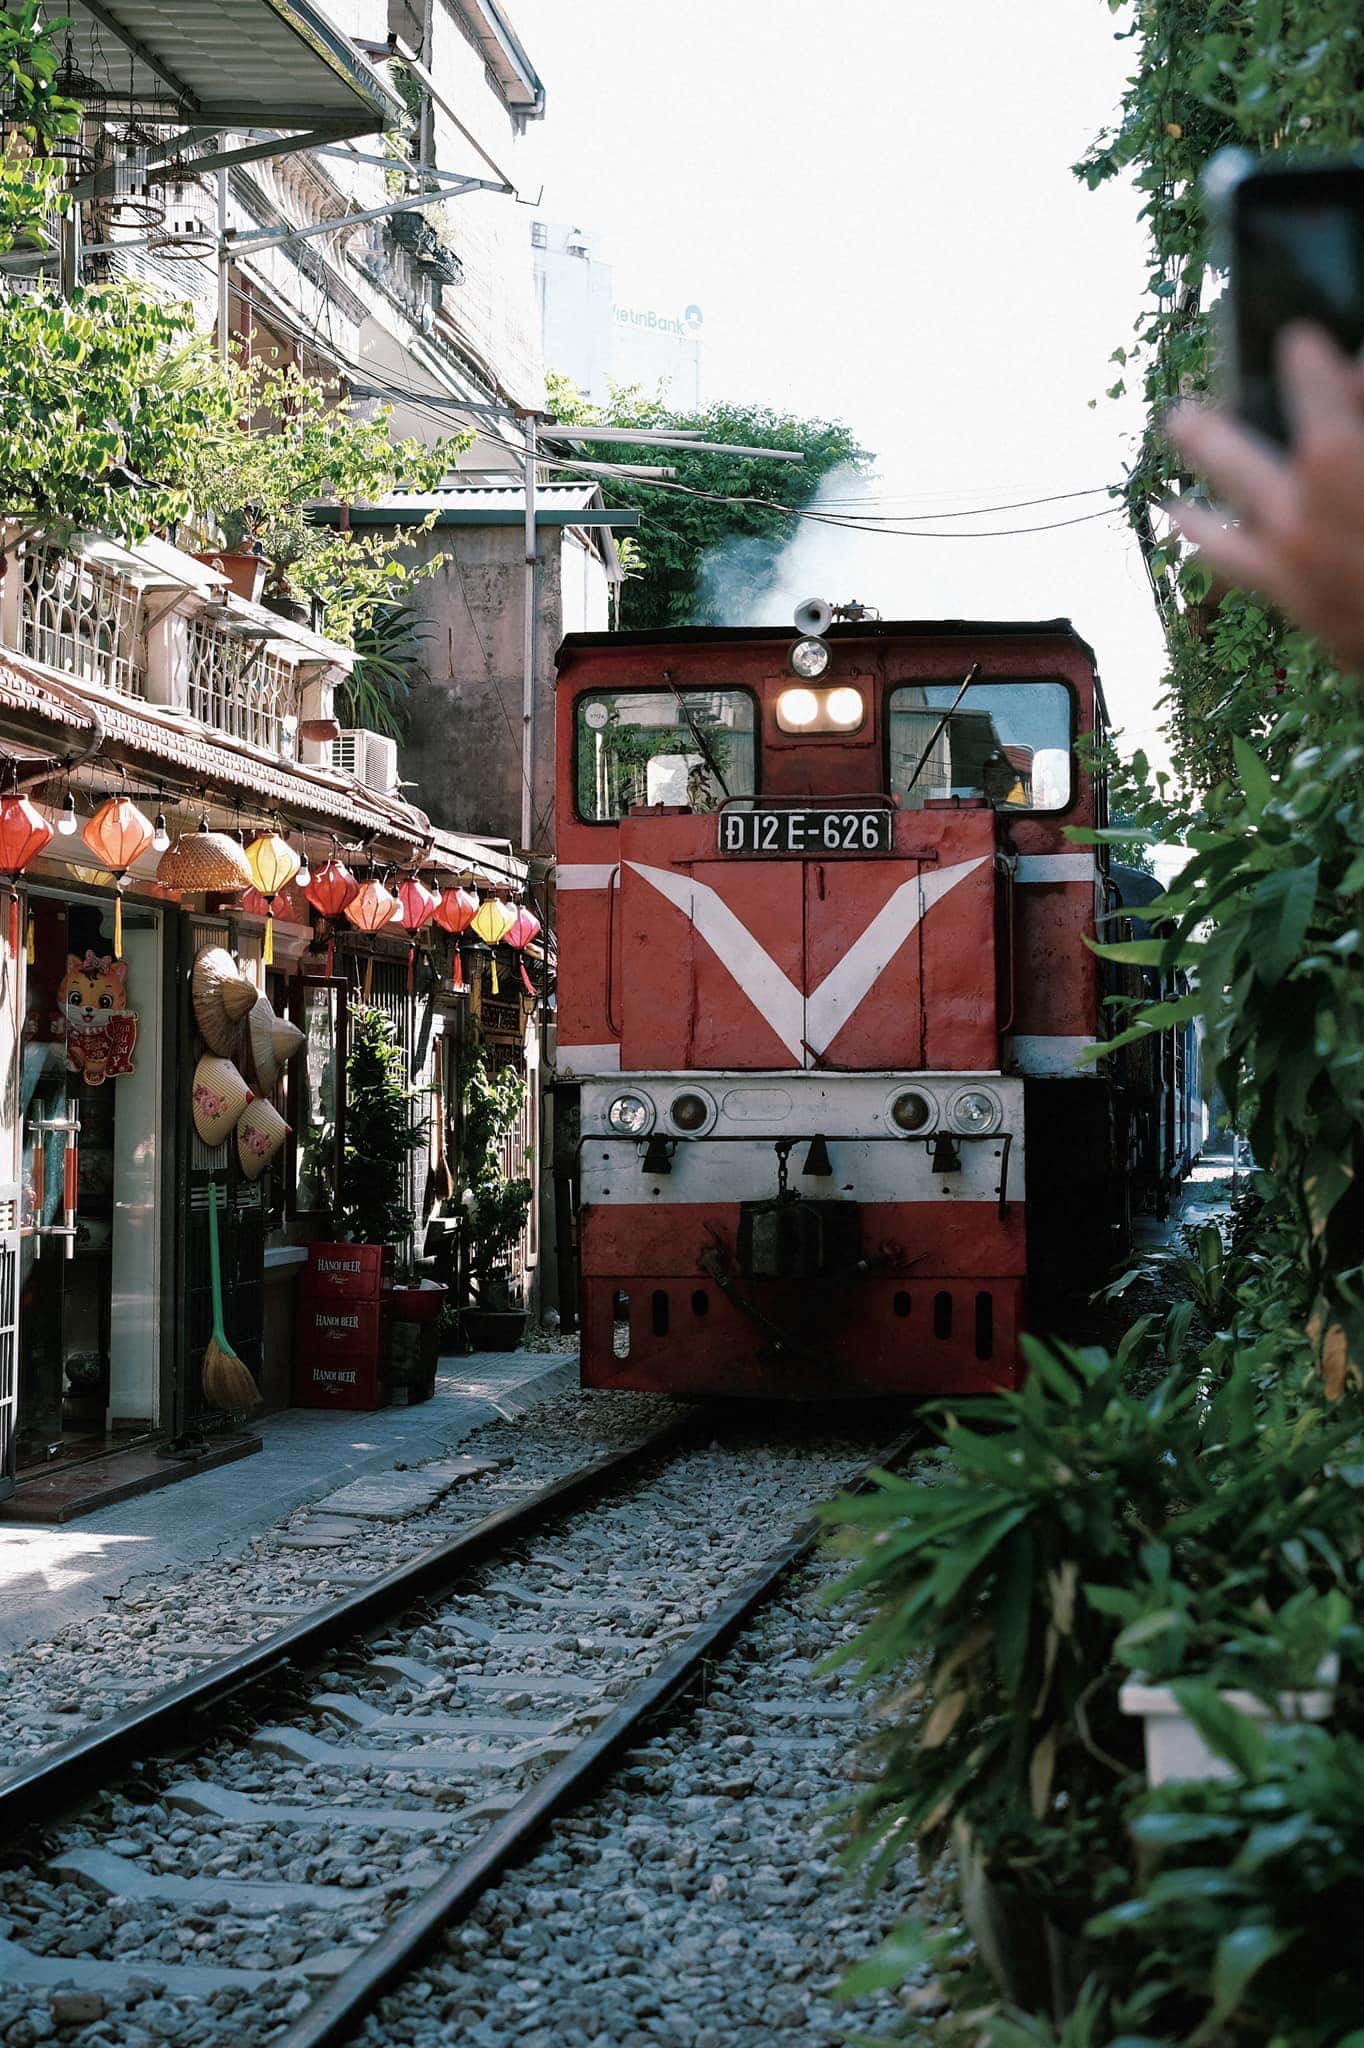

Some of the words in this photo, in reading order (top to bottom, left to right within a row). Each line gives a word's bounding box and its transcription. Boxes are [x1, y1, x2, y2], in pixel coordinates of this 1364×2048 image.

[317, 1258, 341, 1271] HANOI
[342, 1260, 361, 1273] BEER
[316, 1313, 339, 1327] HANOI
[340, 1315, 359, 1328] BEER
[313, 1368, 336, 1381] HANOI
[338, 1370, 356, 1384] BEER
